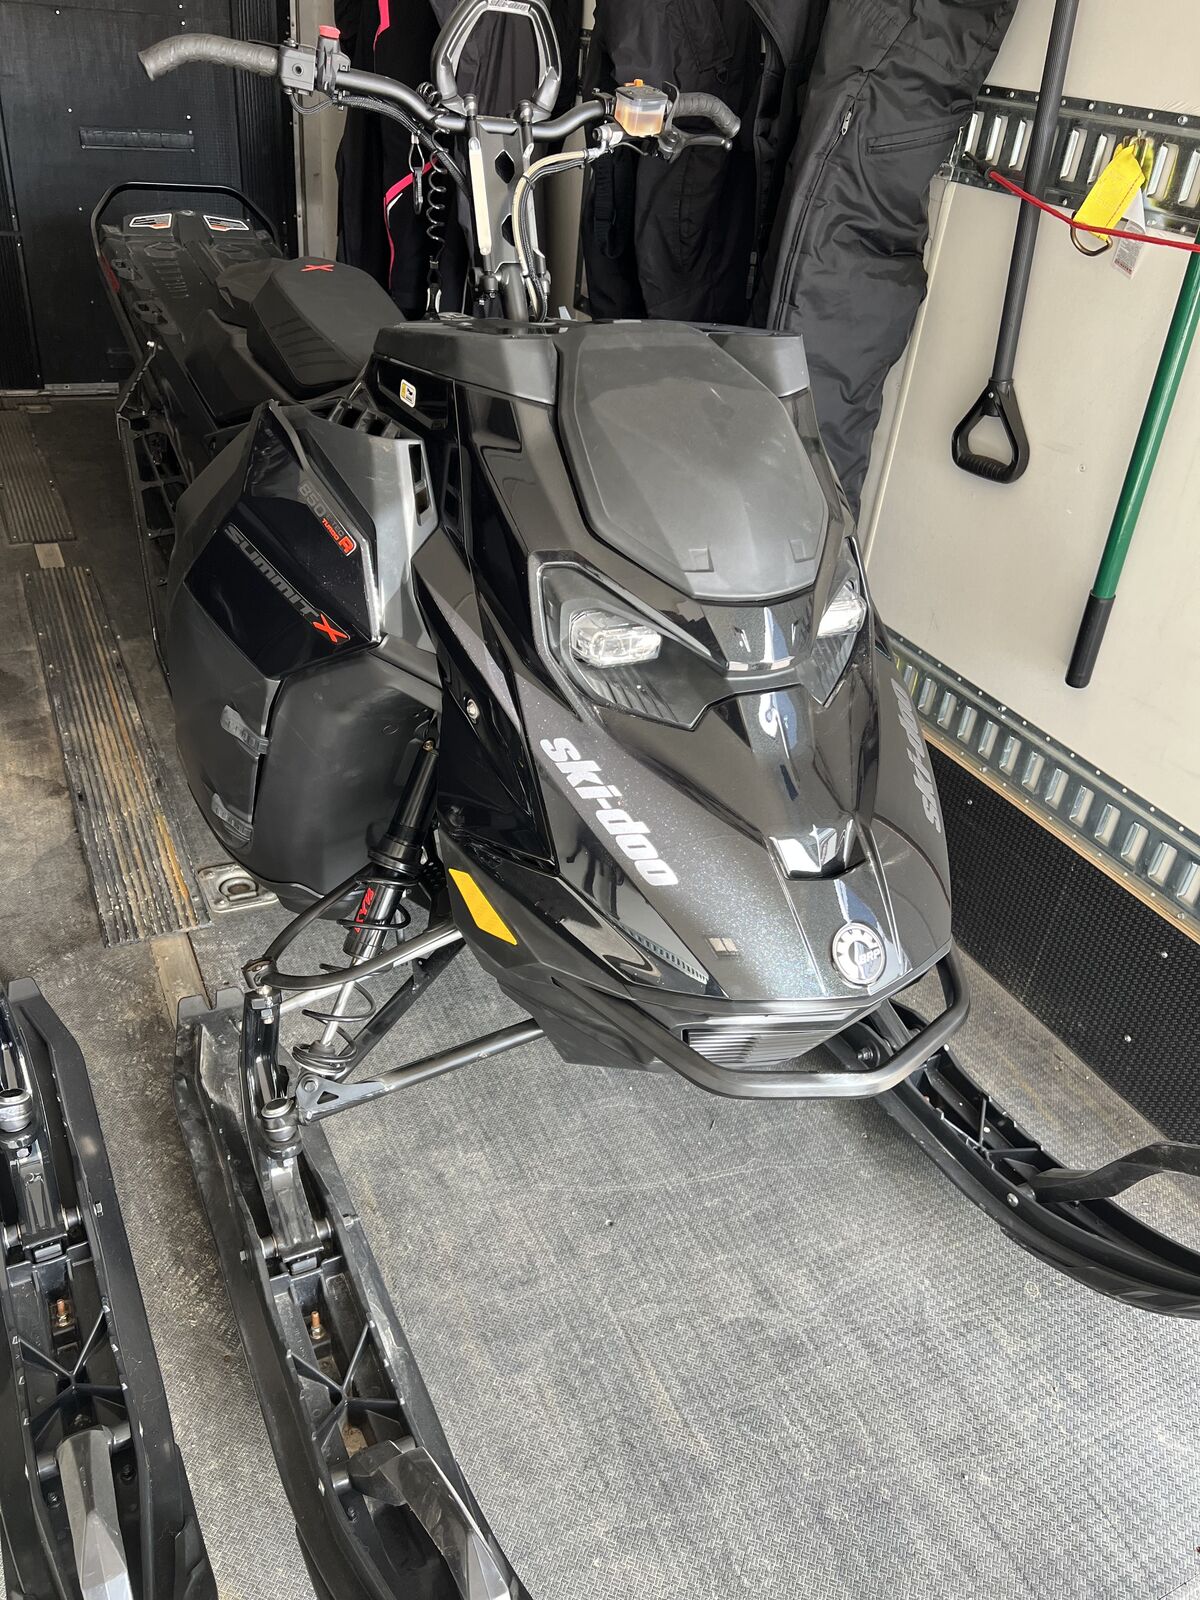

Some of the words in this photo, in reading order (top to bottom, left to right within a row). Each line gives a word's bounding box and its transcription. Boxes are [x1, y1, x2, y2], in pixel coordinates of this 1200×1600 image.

[299, 483, 327, 518] 850
[321, 517, 340, 541] TURBO
[338, 535, 354, 554] R
[224, 523, 320, 617] SUMMIT
[312, 613, 348, 643] X
[891, 678, 942, 833] ski-doo
[540, 738, 679, 886] ski-doo
[859, 948, 881, 965] BRP
